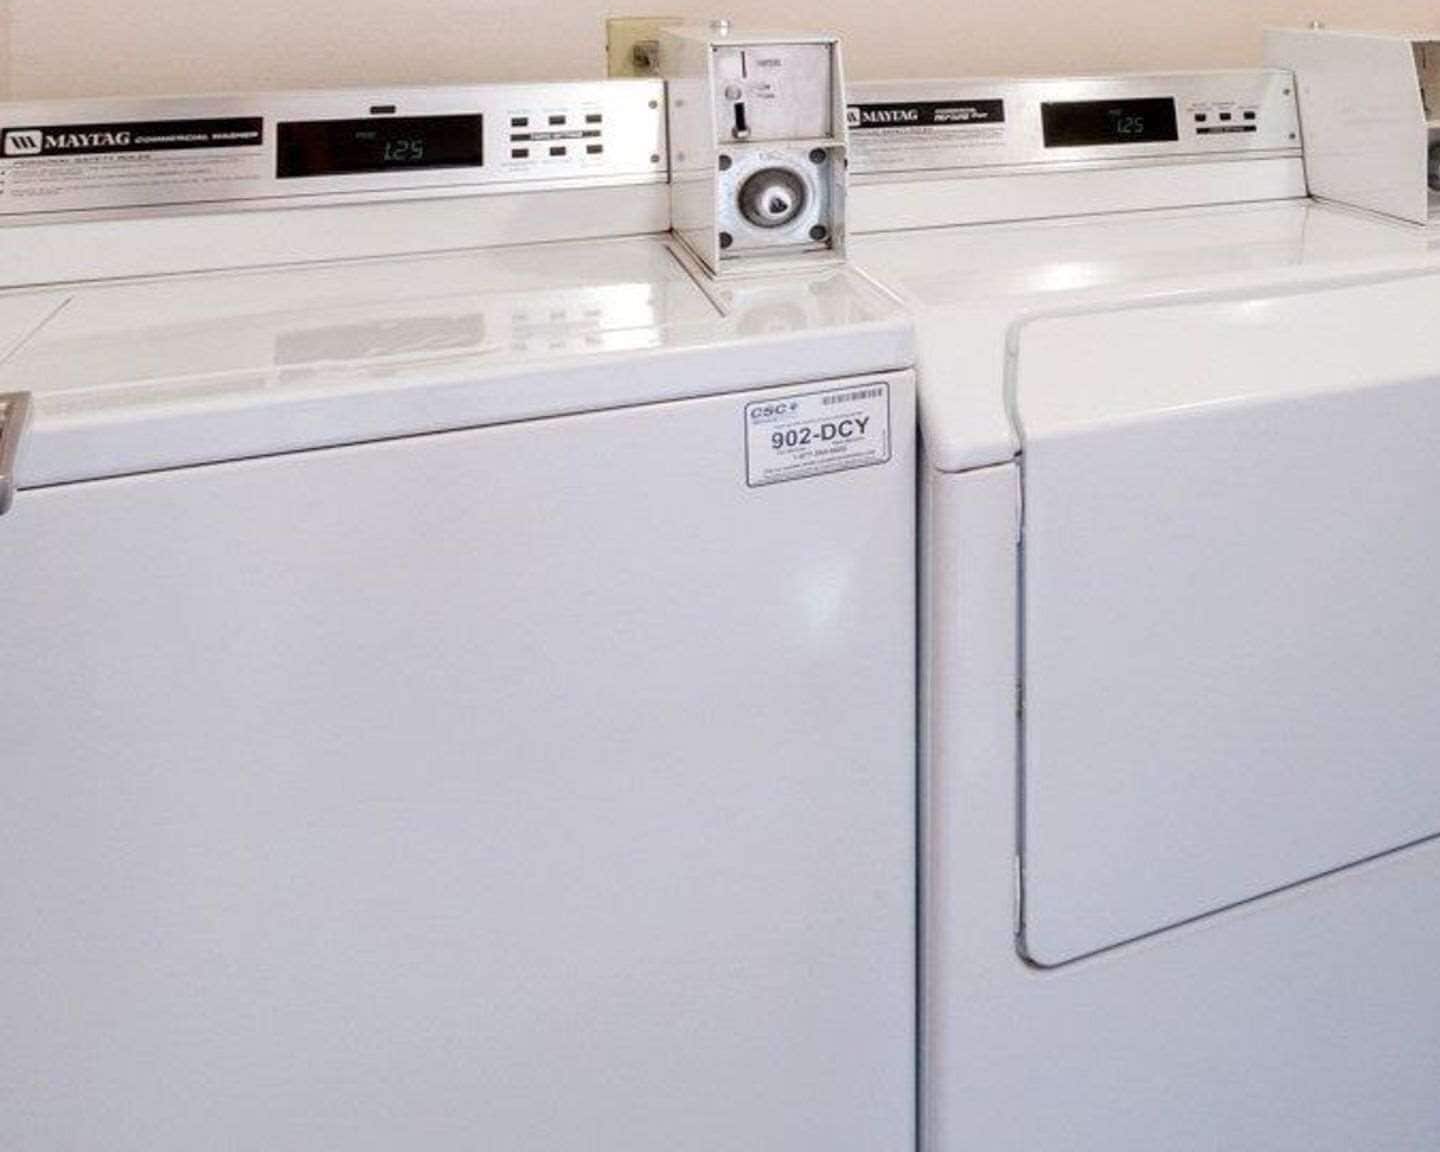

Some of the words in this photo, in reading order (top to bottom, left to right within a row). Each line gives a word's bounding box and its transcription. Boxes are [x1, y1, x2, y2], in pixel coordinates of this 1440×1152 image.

[862, 109, 918, 123] MAYTAG
[45, 132, 131, 149] MAYTAG
[751, 404, 787, 419] CSC
[772, 416, 869, 450] 902-DCY
